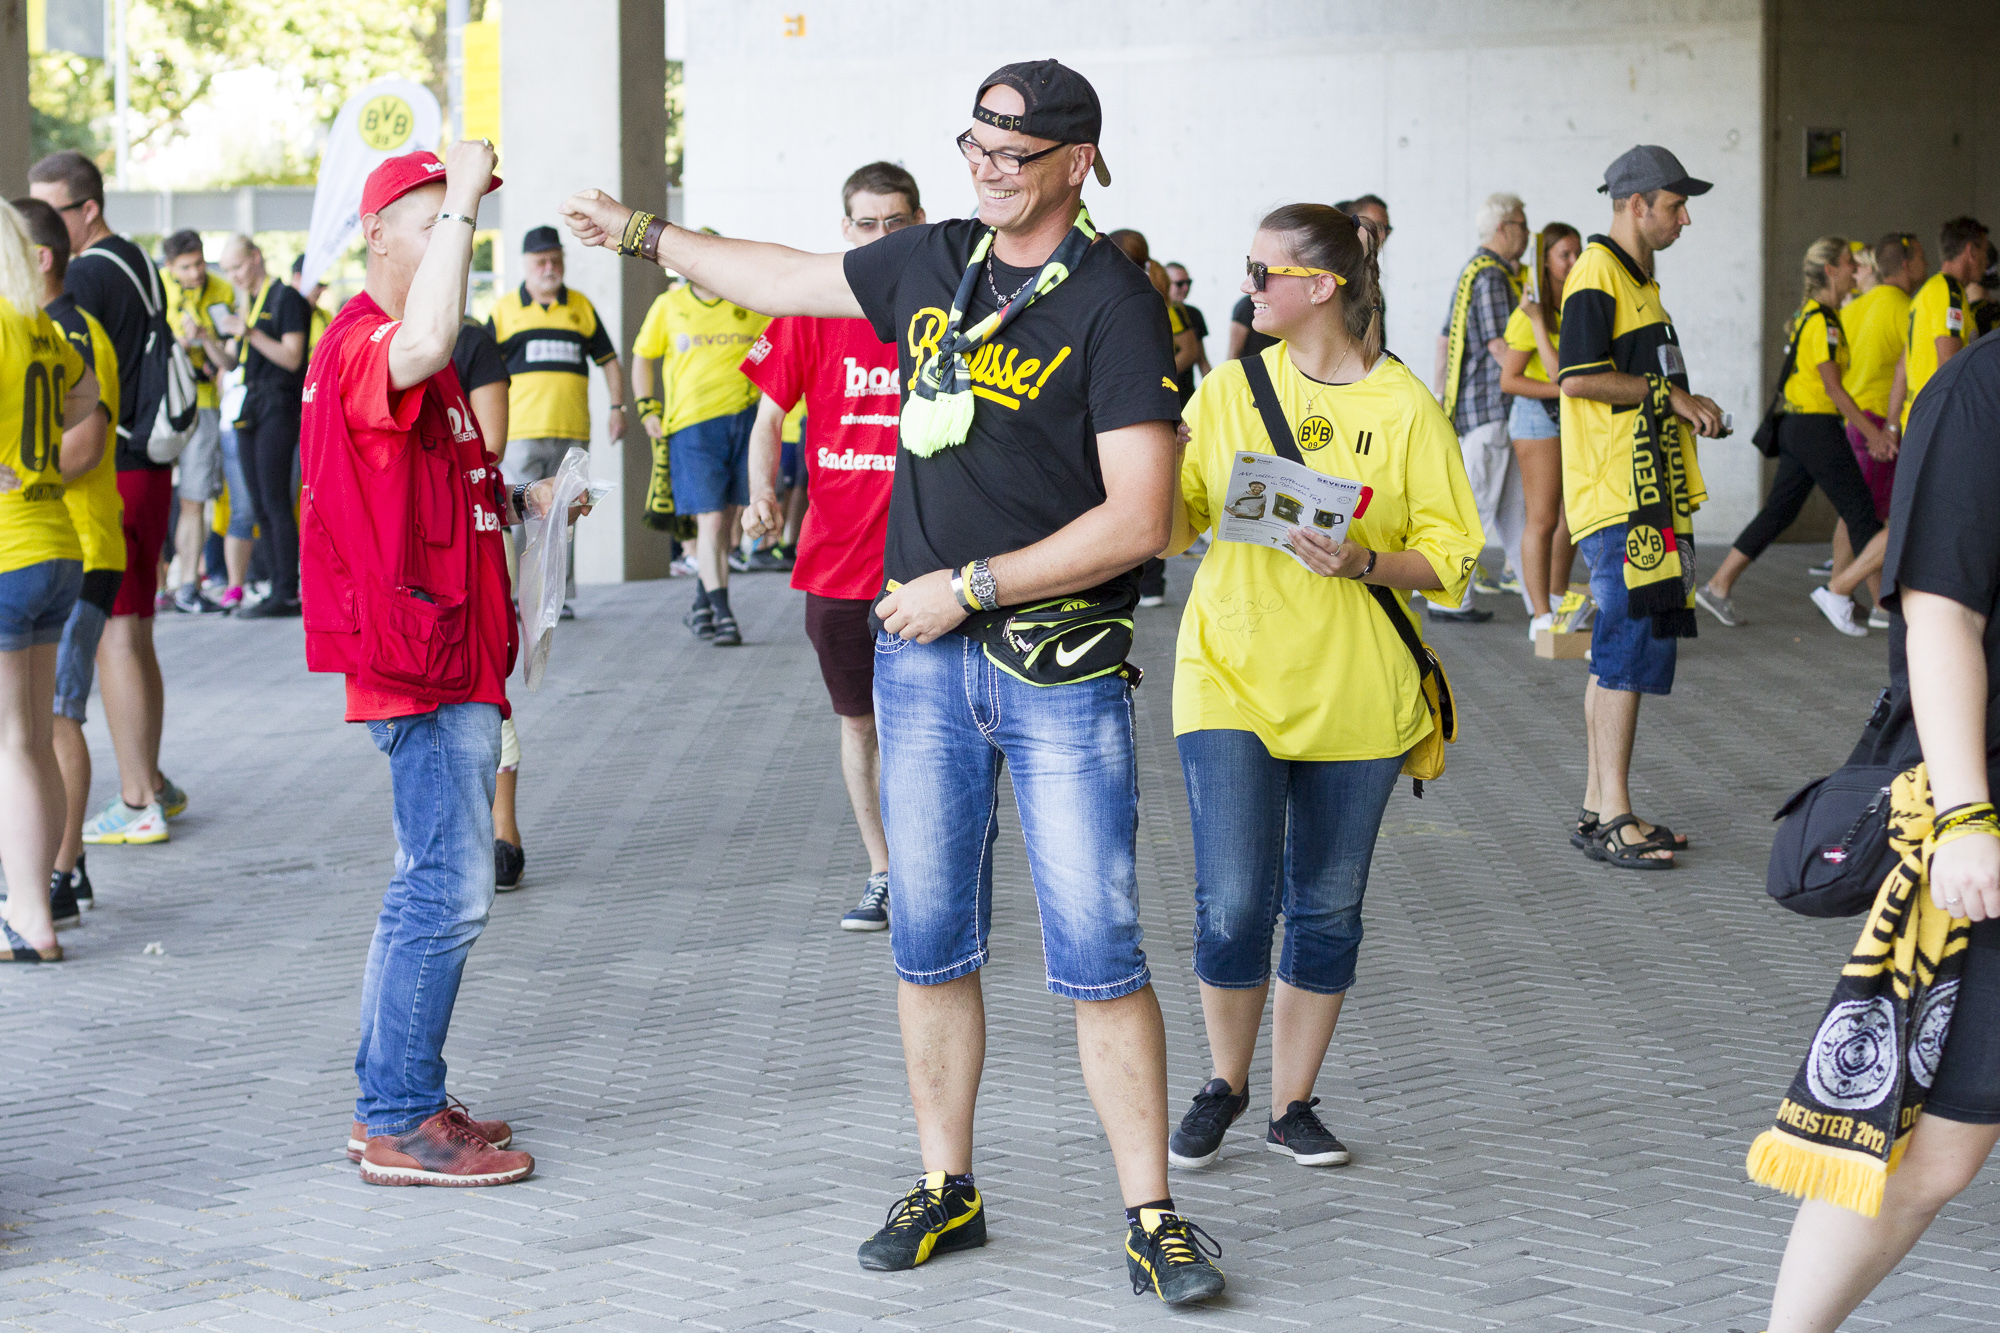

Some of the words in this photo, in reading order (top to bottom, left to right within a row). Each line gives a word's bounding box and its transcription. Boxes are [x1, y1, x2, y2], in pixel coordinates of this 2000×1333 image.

[365, 100, 408, 135] BVB
[1301, 420, 1331, 442] BVB
[1317, 477, 1357, 490] SEVERIN
[1628, 527, 1662, 558] BVB
[1641, 553, 1656, 566] 09
[1776, 1097, 1855, 1141] MEISTER
[1853, 1121, 1887, 1154] 2012
